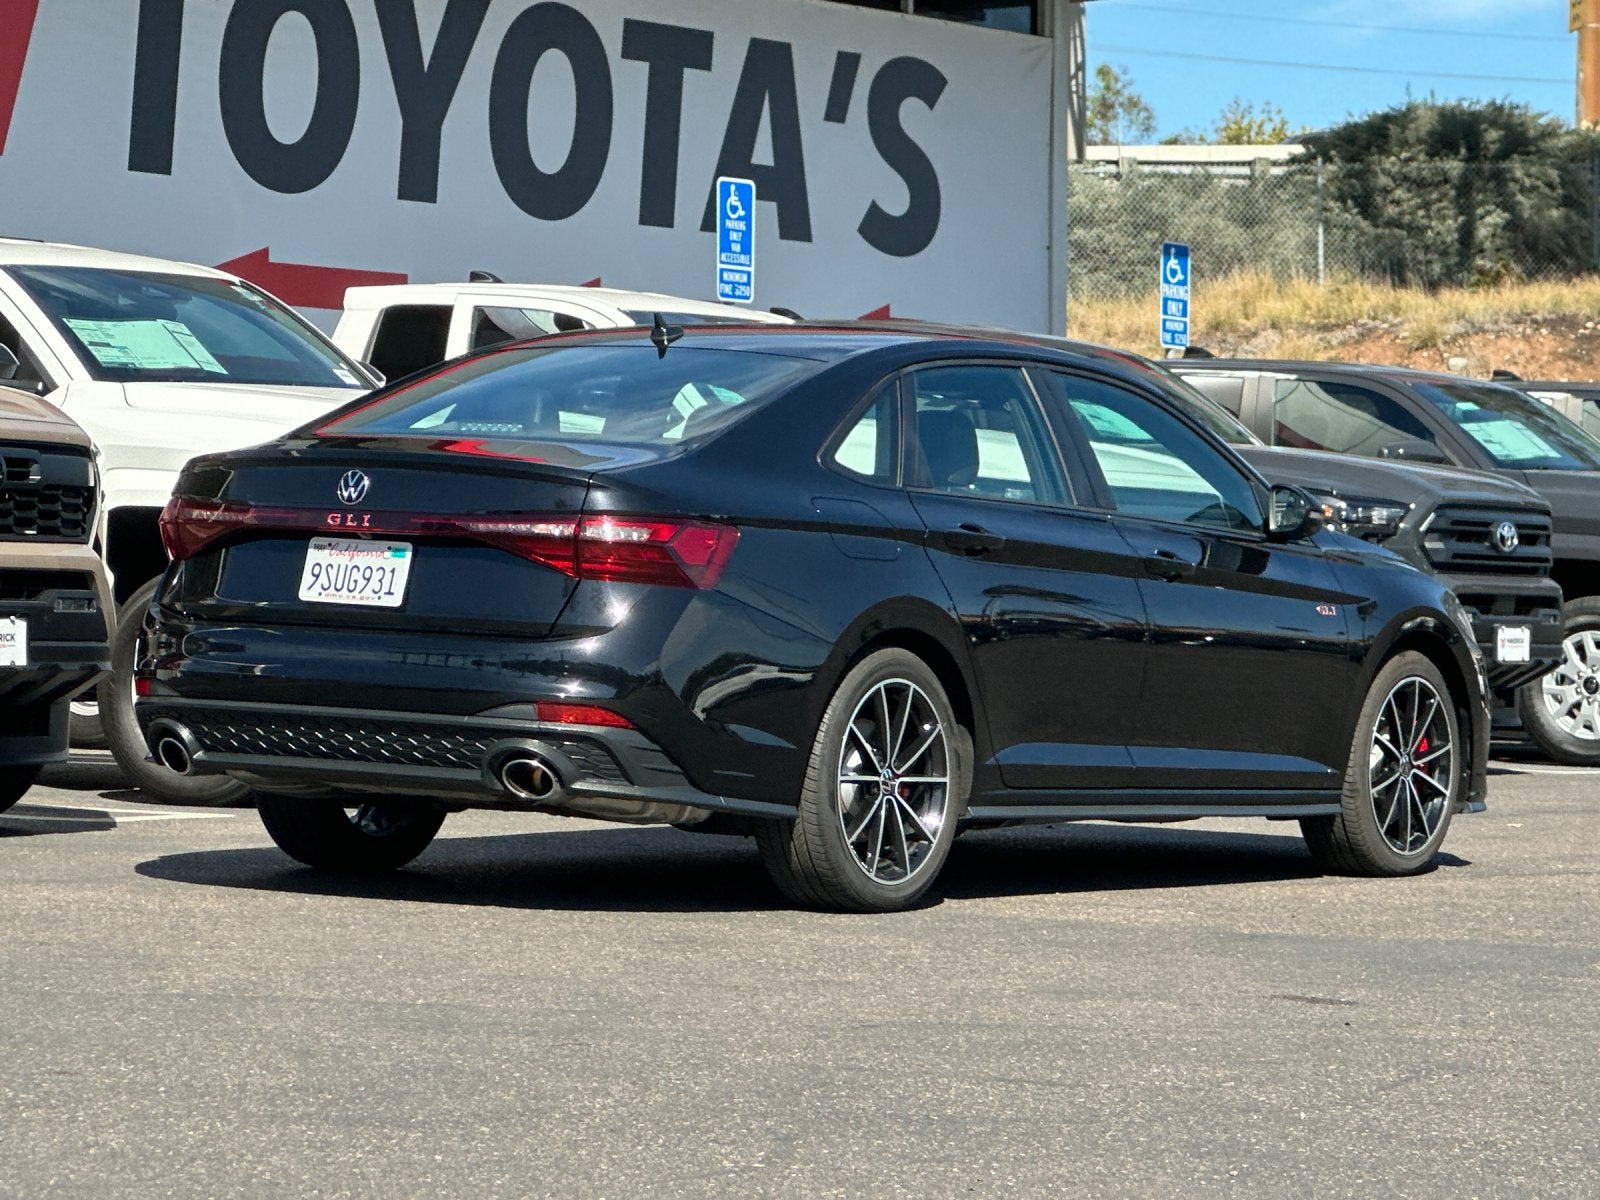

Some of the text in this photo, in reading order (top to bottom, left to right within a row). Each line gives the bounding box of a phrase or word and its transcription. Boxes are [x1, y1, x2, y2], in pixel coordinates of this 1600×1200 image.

[128, 0, 949, 258] TOYOTA'S
[726, 219, 746, 231] PARKING
[730, 231, 742, 241] ONLY
[721, 253, 750, 264] ACCESSIBLE
[720, 284, 732, 295] FINE
[1162, 284, 1188, 299] PARKING
[327, 513, 371, 527] GLI
[328, 542, 391, 562] California
[306, 562, 397, 596] 9SUG931
